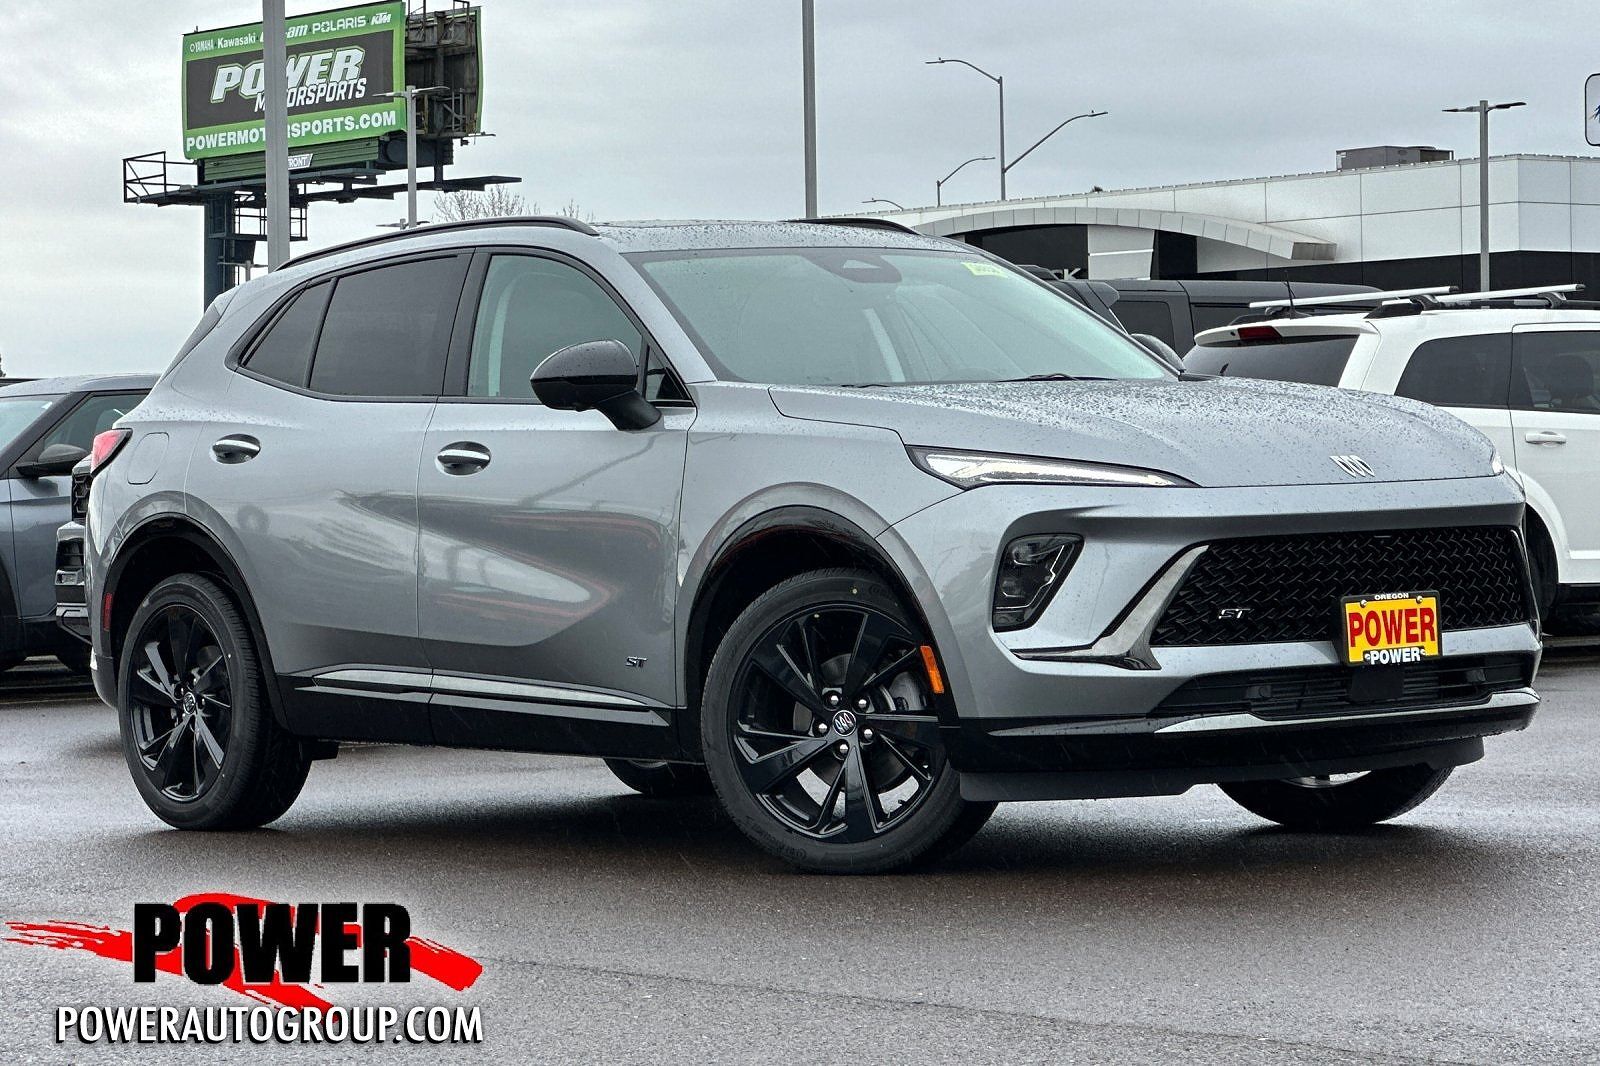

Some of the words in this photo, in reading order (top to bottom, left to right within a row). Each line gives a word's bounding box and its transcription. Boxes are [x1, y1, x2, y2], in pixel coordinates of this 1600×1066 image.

[217, 32, 256, 48] Kawasaki
[312, 15, 366, 34] POLARIS
[371, 11, 391, 26] KTM
[254, 78, 367, 112] MORSPORTS
[186, 111, 396, 151] POWERMOTSPORTS.COM
[1374, 592, 1409, 601] OREGON
[1348, 607, 1436, 648] POWER
[625, 656, 648, 668] ST
[1369, 646, 1421, 665] POWER
